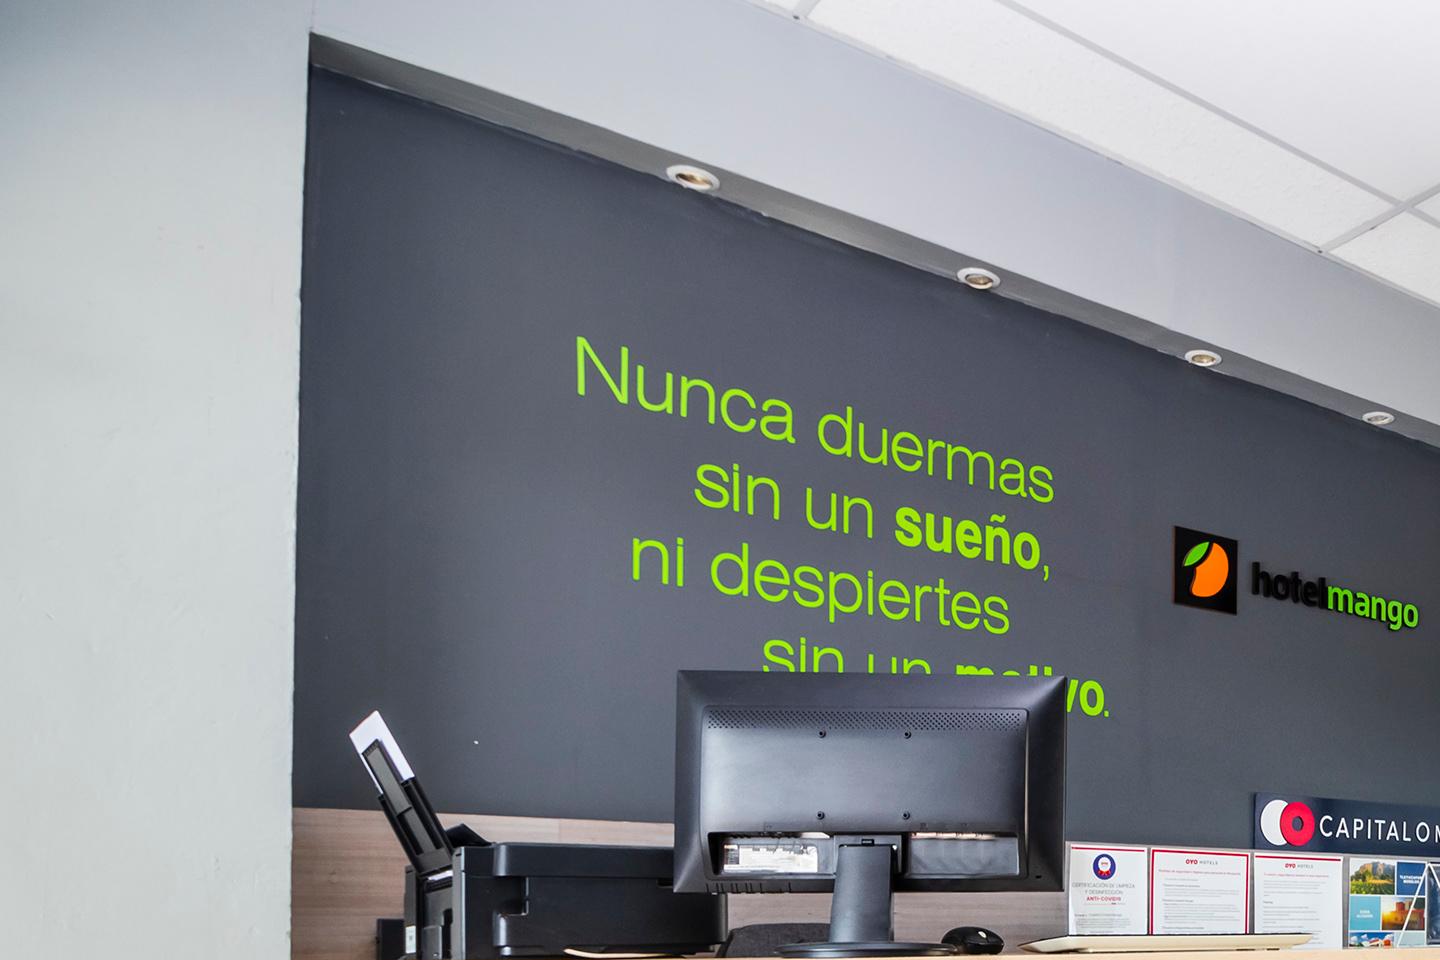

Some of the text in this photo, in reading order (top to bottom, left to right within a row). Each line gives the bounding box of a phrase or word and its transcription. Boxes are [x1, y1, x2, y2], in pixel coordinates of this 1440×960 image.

[576, 336, 1055, 503] Nunca duermas
[694, 463, 1050, 582] sin un sueño,
[631, 536, 1010, 635] ni despiertes
[1319, 815, 1412, 842] CAPITAL
